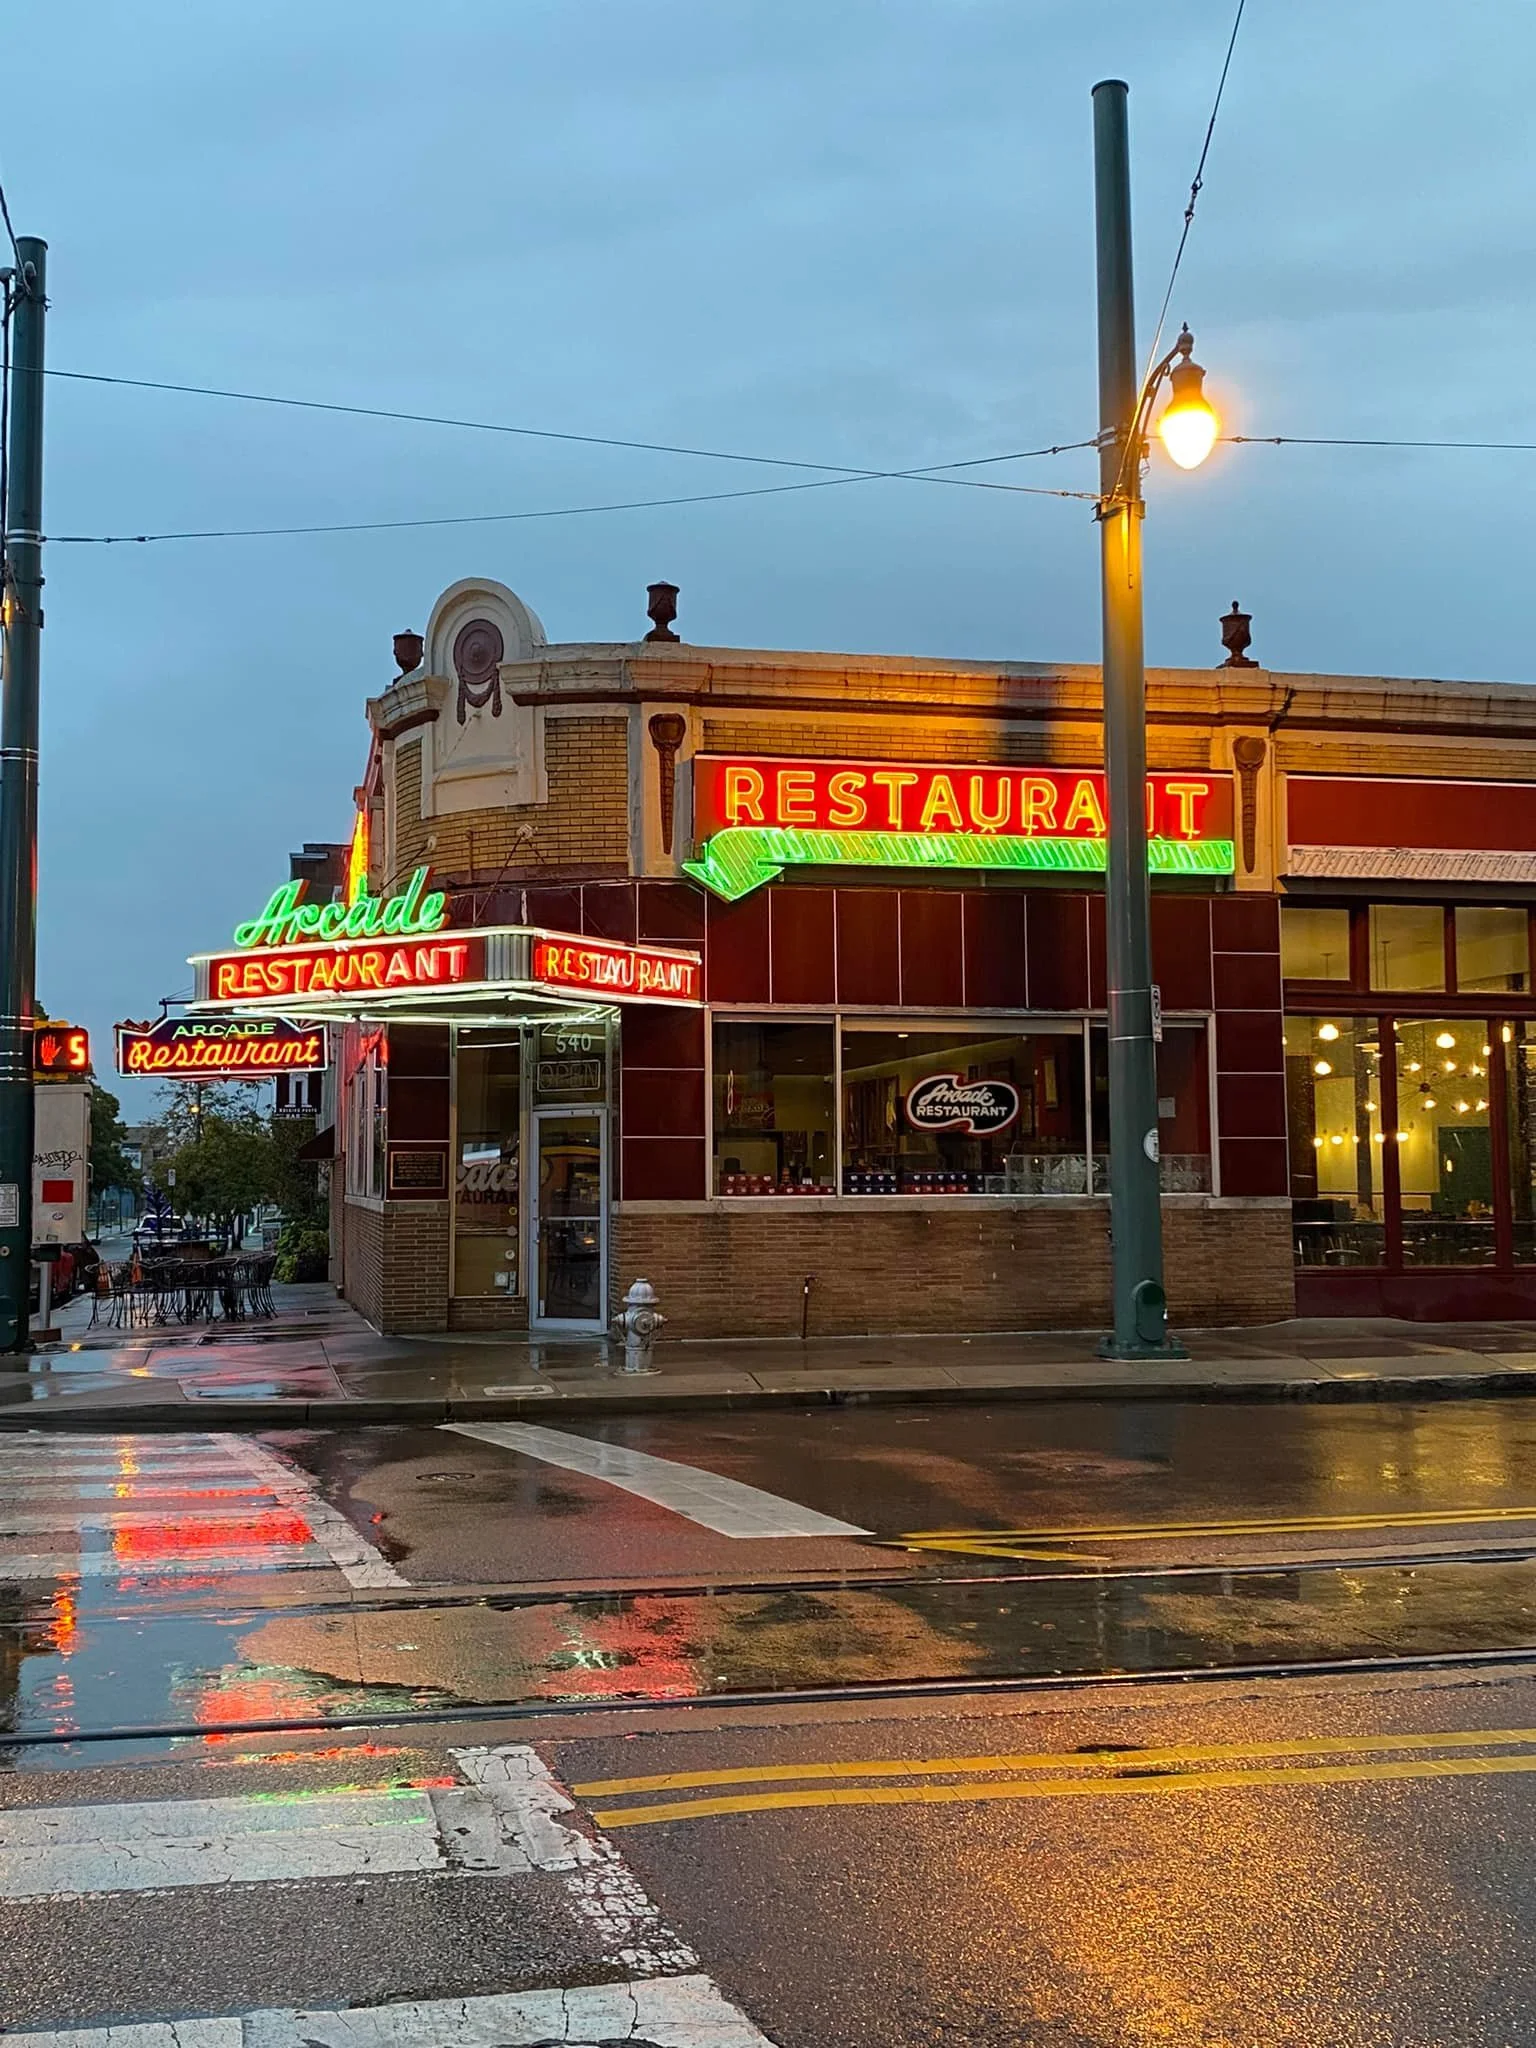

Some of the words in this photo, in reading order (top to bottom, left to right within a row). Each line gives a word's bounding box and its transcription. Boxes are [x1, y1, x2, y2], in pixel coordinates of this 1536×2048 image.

[725, 766, 1208, 835] RESTAURAT
[234, 866, 449, 945] Arcade
[218, 945, 468, 998] RESTAURANT
[545, 946, 695, 995] RESTAURANT
[172, 1023, 277, 1039] ARCADE
[556, 1032, 592, 1054] 540
[69, 1035, 86, 1066] 5
[127, 1036, 320, 1070] Restaurant
[541, 1063, 598, 1089] OPEN
[918, 1082, 995, 1107] Arcade
[916, 1105, 1008, 1117] RESTAURANT
